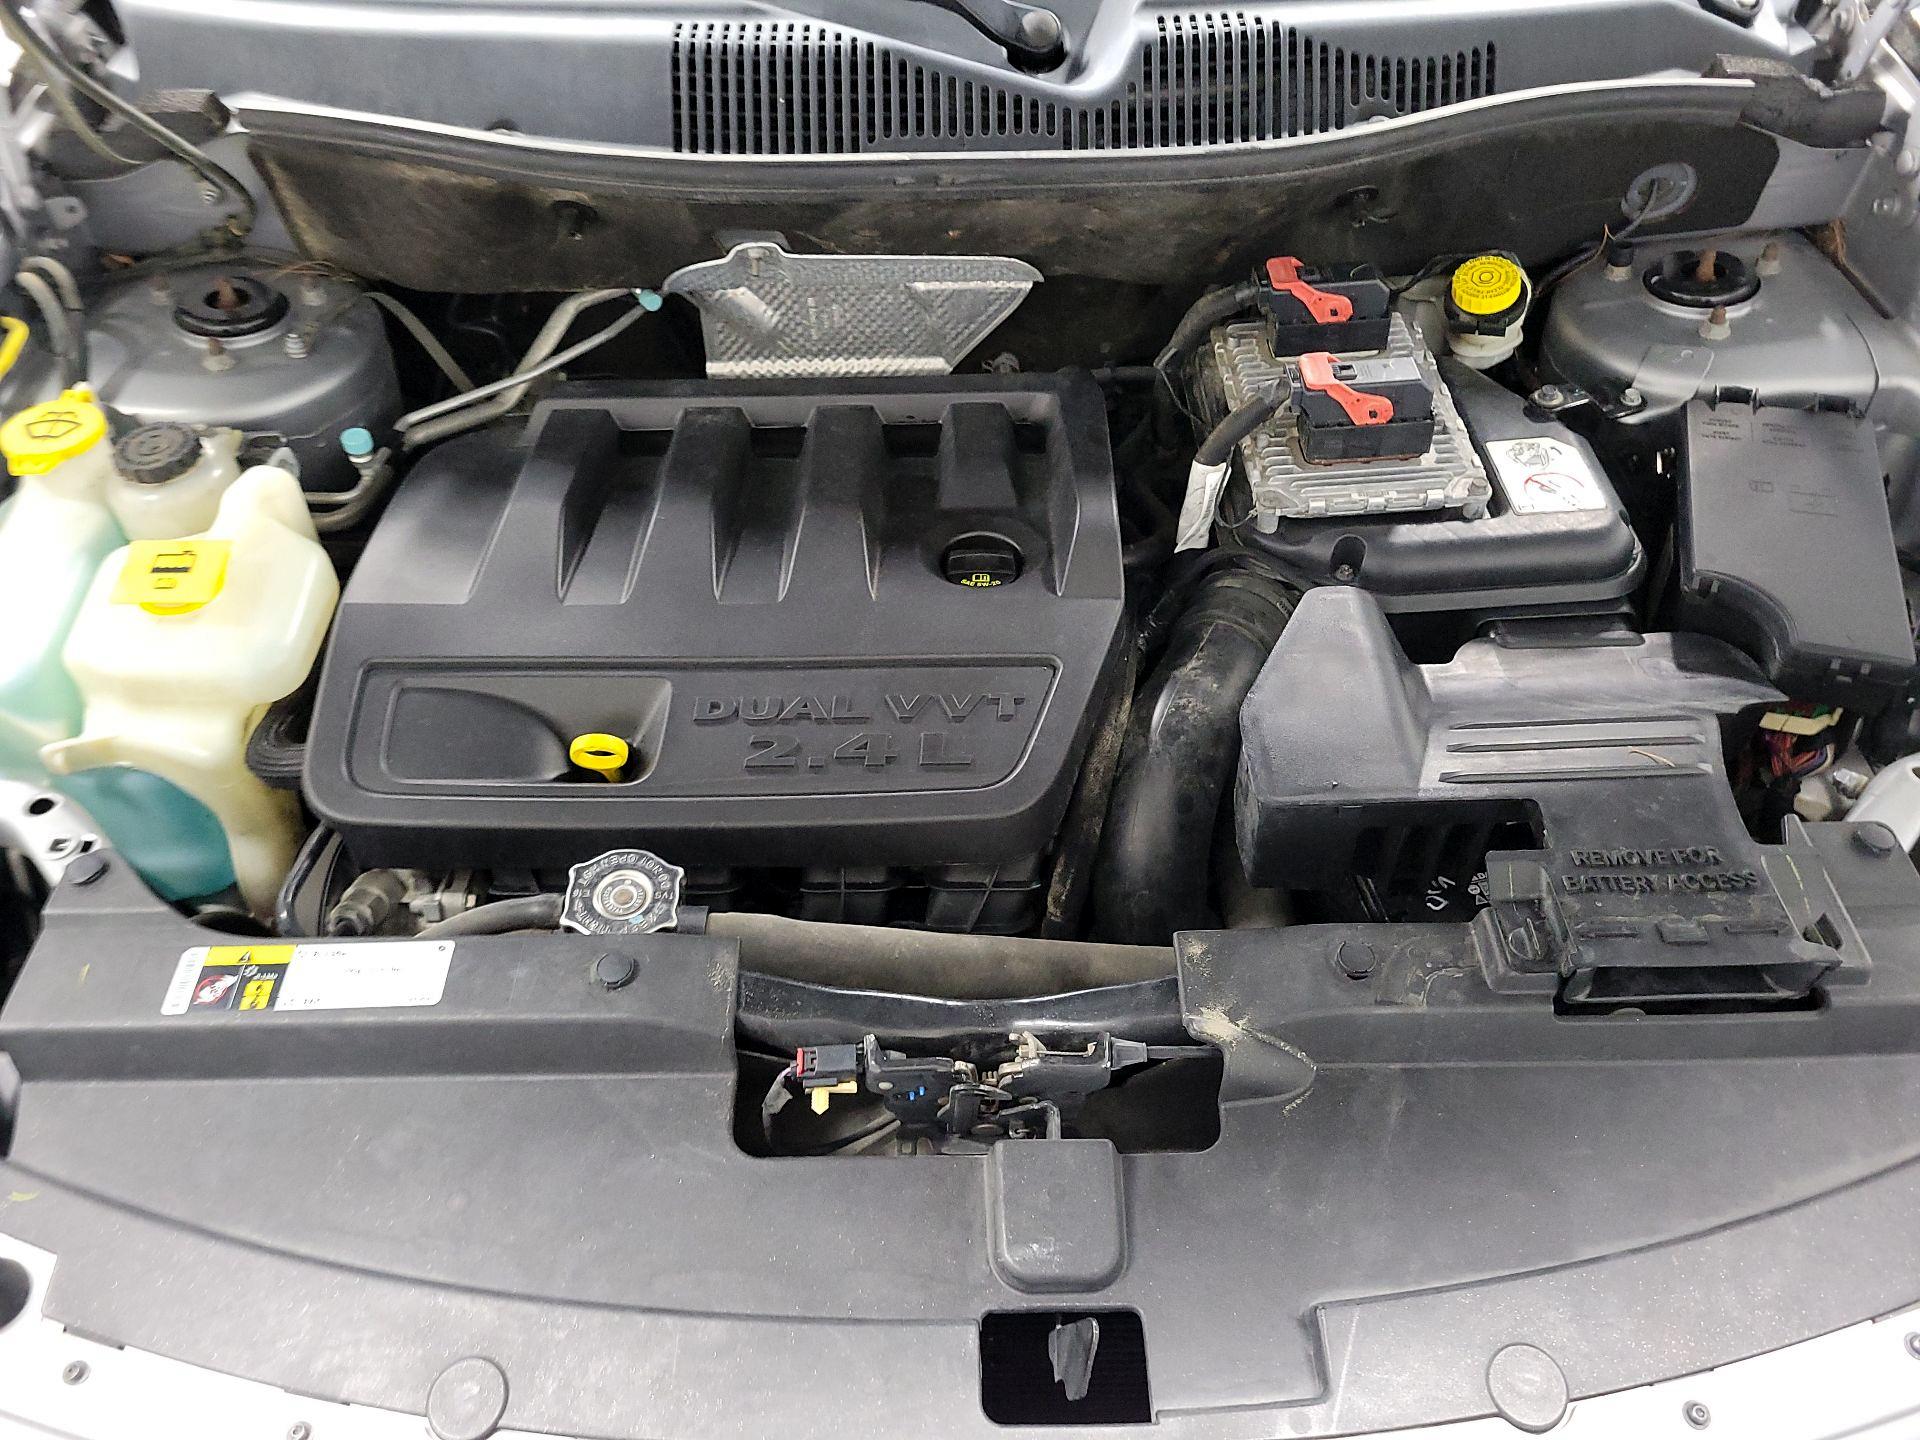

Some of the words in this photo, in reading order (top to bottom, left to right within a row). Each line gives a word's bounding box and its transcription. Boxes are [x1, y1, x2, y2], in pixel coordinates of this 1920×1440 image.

[693, 696, 870, 723] DUAL
[884, 693, 1025, 722] VVT
[1571, 848, 1668, 867] REMOVE
[1671, 847, 1725, 865] FOR
[1562, 873, 1658, 893] BATTERY
[1669, 870, 1761, 891] ACCESS
